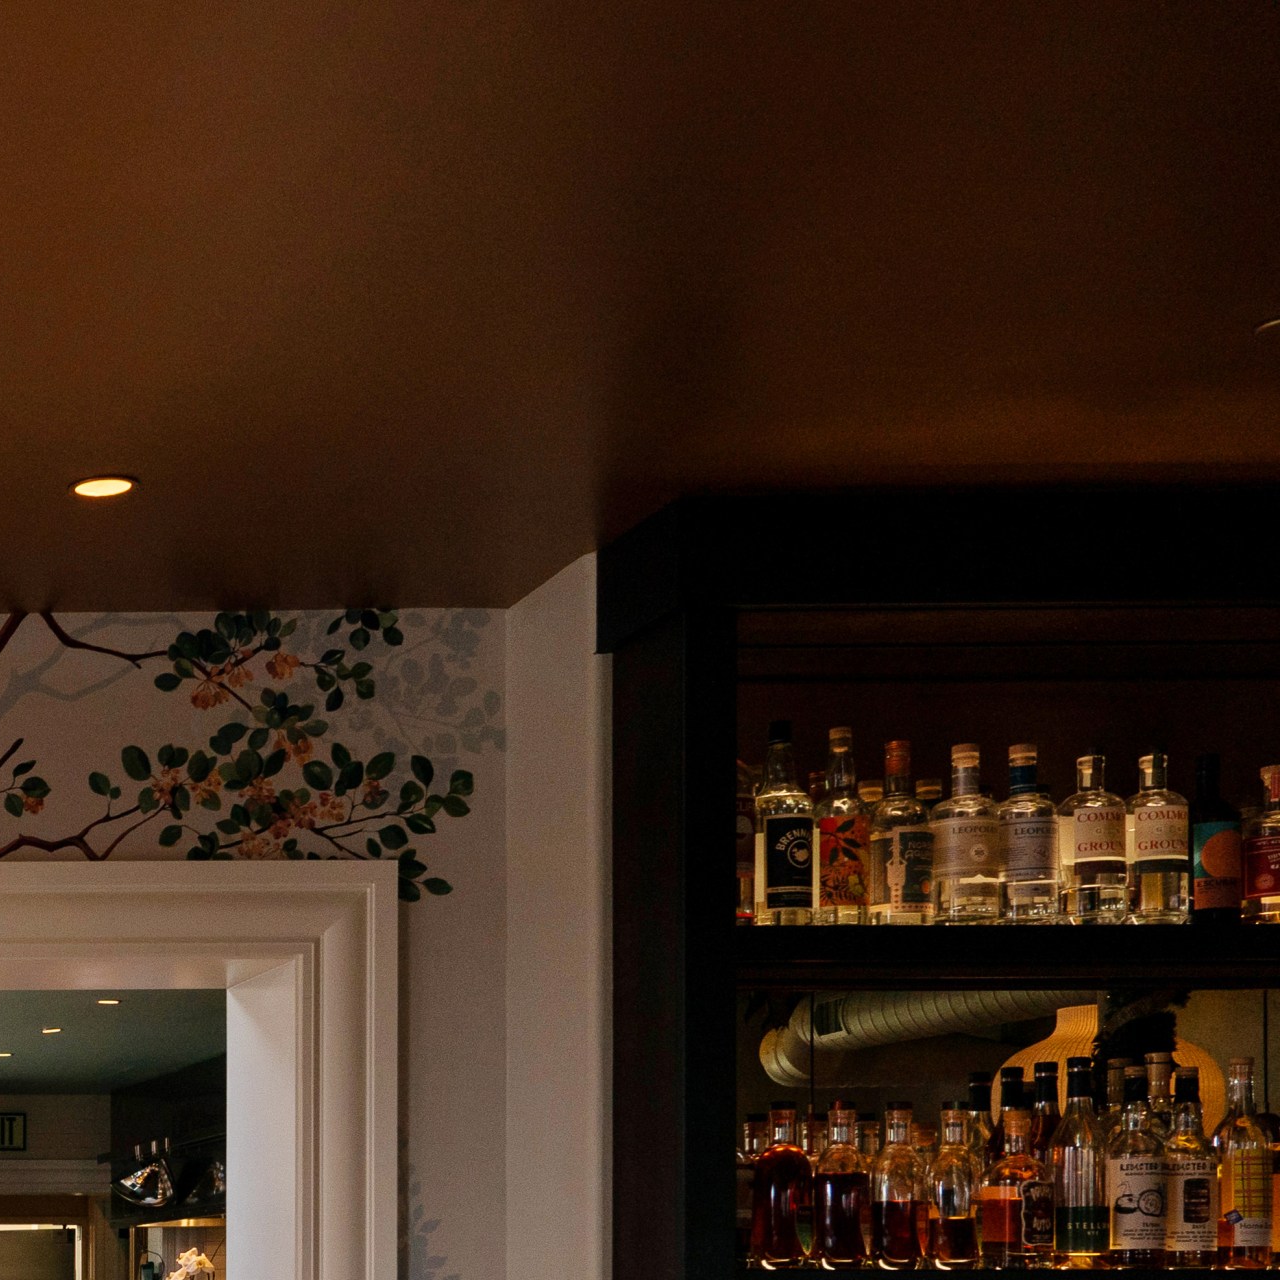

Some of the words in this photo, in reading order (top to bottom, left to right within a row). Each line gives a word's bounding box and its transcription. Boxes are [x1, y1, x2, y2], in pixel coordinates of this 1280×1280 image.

[1077, 810, 1125, 823] COMMO
[1138, 809, 1187, 822] COMMO
[1077, 841, 1125, 852] GROU
[1138, 840, 1187, 851] GROUN
[1067, 1221, 1110, 1230] STELLU
